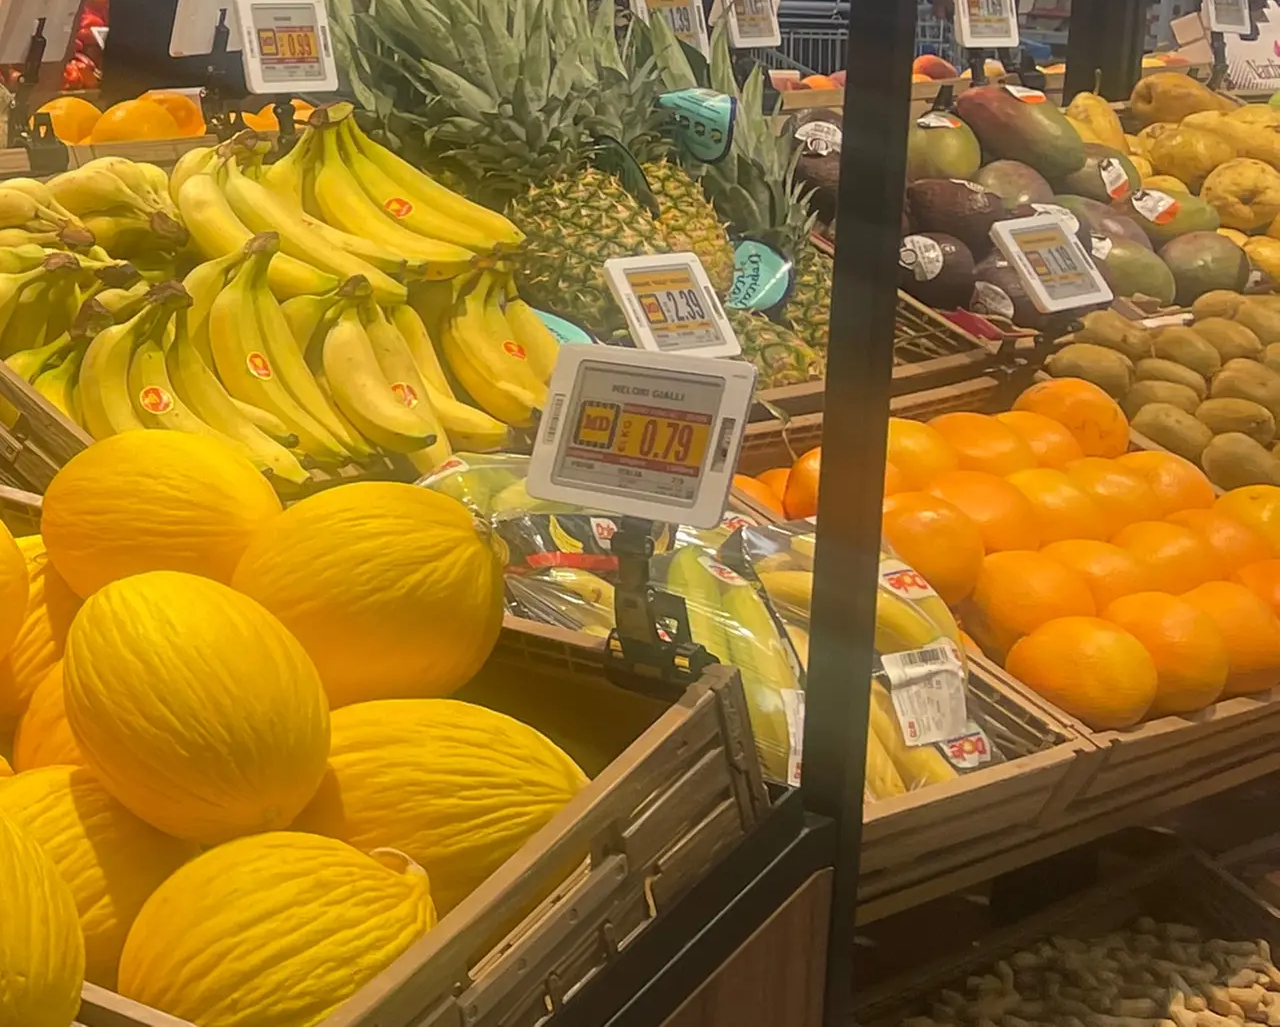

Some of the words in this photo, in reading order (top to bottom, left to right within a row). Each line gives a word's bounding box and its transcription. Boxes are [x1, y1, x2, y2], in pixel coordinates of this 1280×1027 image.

[669, 6, 690, 32] 1.39
[288, 33, 312, 57] 0.99
[666, 289, 705, 322] 2.39
[583, 414, 611, 432] MD
[639, 419, 694, 462] 0.79
[888, 573, 928, 593] Dole
[948, 736, 987, 762] Dole
